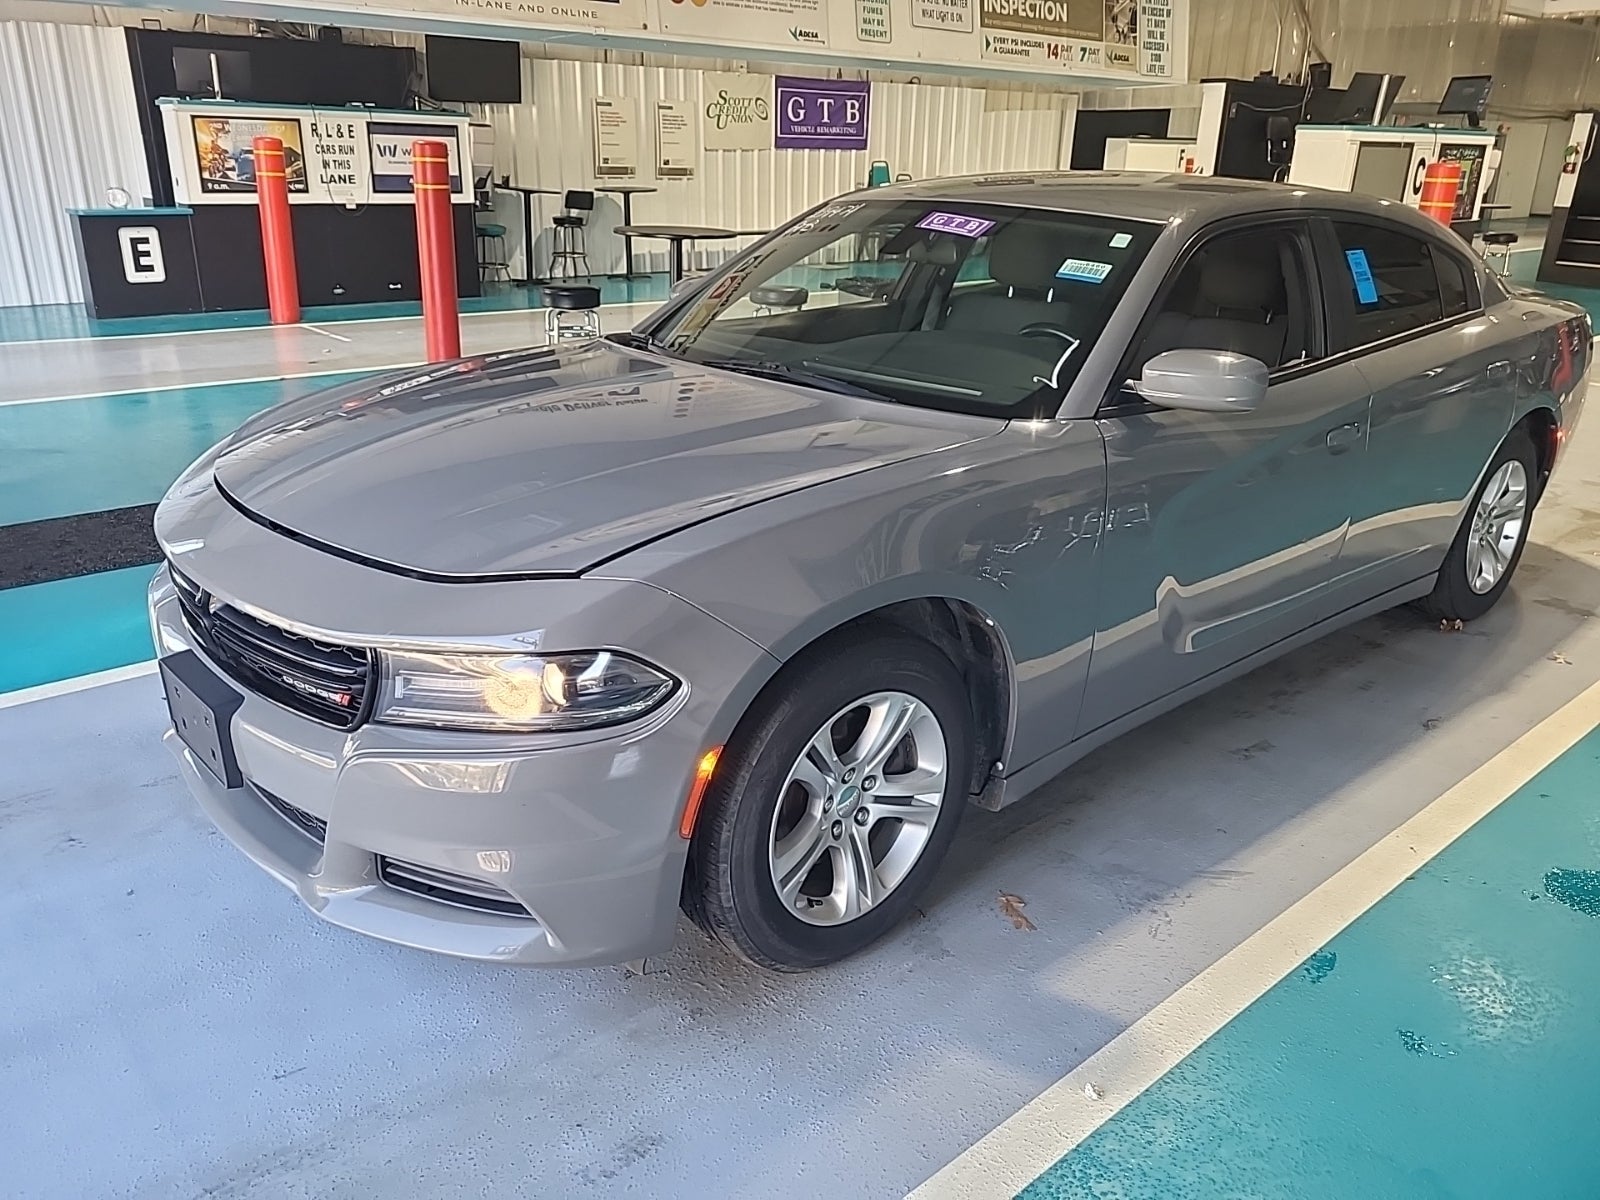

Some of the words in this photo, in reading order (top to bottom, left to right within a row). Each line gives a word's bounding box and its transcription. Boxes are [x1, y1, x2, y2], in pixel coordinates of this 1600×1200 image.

[455, 0, 512, 10] IN-LANE
[518, 4, 545, 14] AND
[551, 7, 599, 19] ONLINE
[863, 6, 883, 15] FUMES
[984, 0, 1067, 22] INSPECTION
[863, 17, 876, 25] MAY
[877, 19, 885, 27] BE
[861, 28, 887, 38] PRESENT
[993, 36, 1009, 45] EVERY
[1020, 40, 1044, 49] INCLUDES
[999, 48, 1030, 57] GUARANTEE
[1047, 43, 1059, 60] 14
[1080, 47, 1088, 62] 7
[717, 89, 753, 106] SCOTT
[706, 102, 750, 119] CREDIT
[717, 114, 753, 129] UNION
[326, 123, 333, 138] L
[336, 124, 344, 138] &
[348, 124, 355, 139] E
[790, 125, 815, 133] VEHICLE
[816, 126, 857, 134] REMARKETING
[315, 144, 336, 155] CARS
[339, 145, 355, 156] RUN
[322, 160, 330, 169] IN
[333, 160, 351, 170] THIS
[1178, 149, 1185, 168] F
[320, 174, 356, 184] LANE
[1413, 157, 1426, 195] C
[129, 237, 155, 272] E
[283, 675, 340, 702] DODGE
